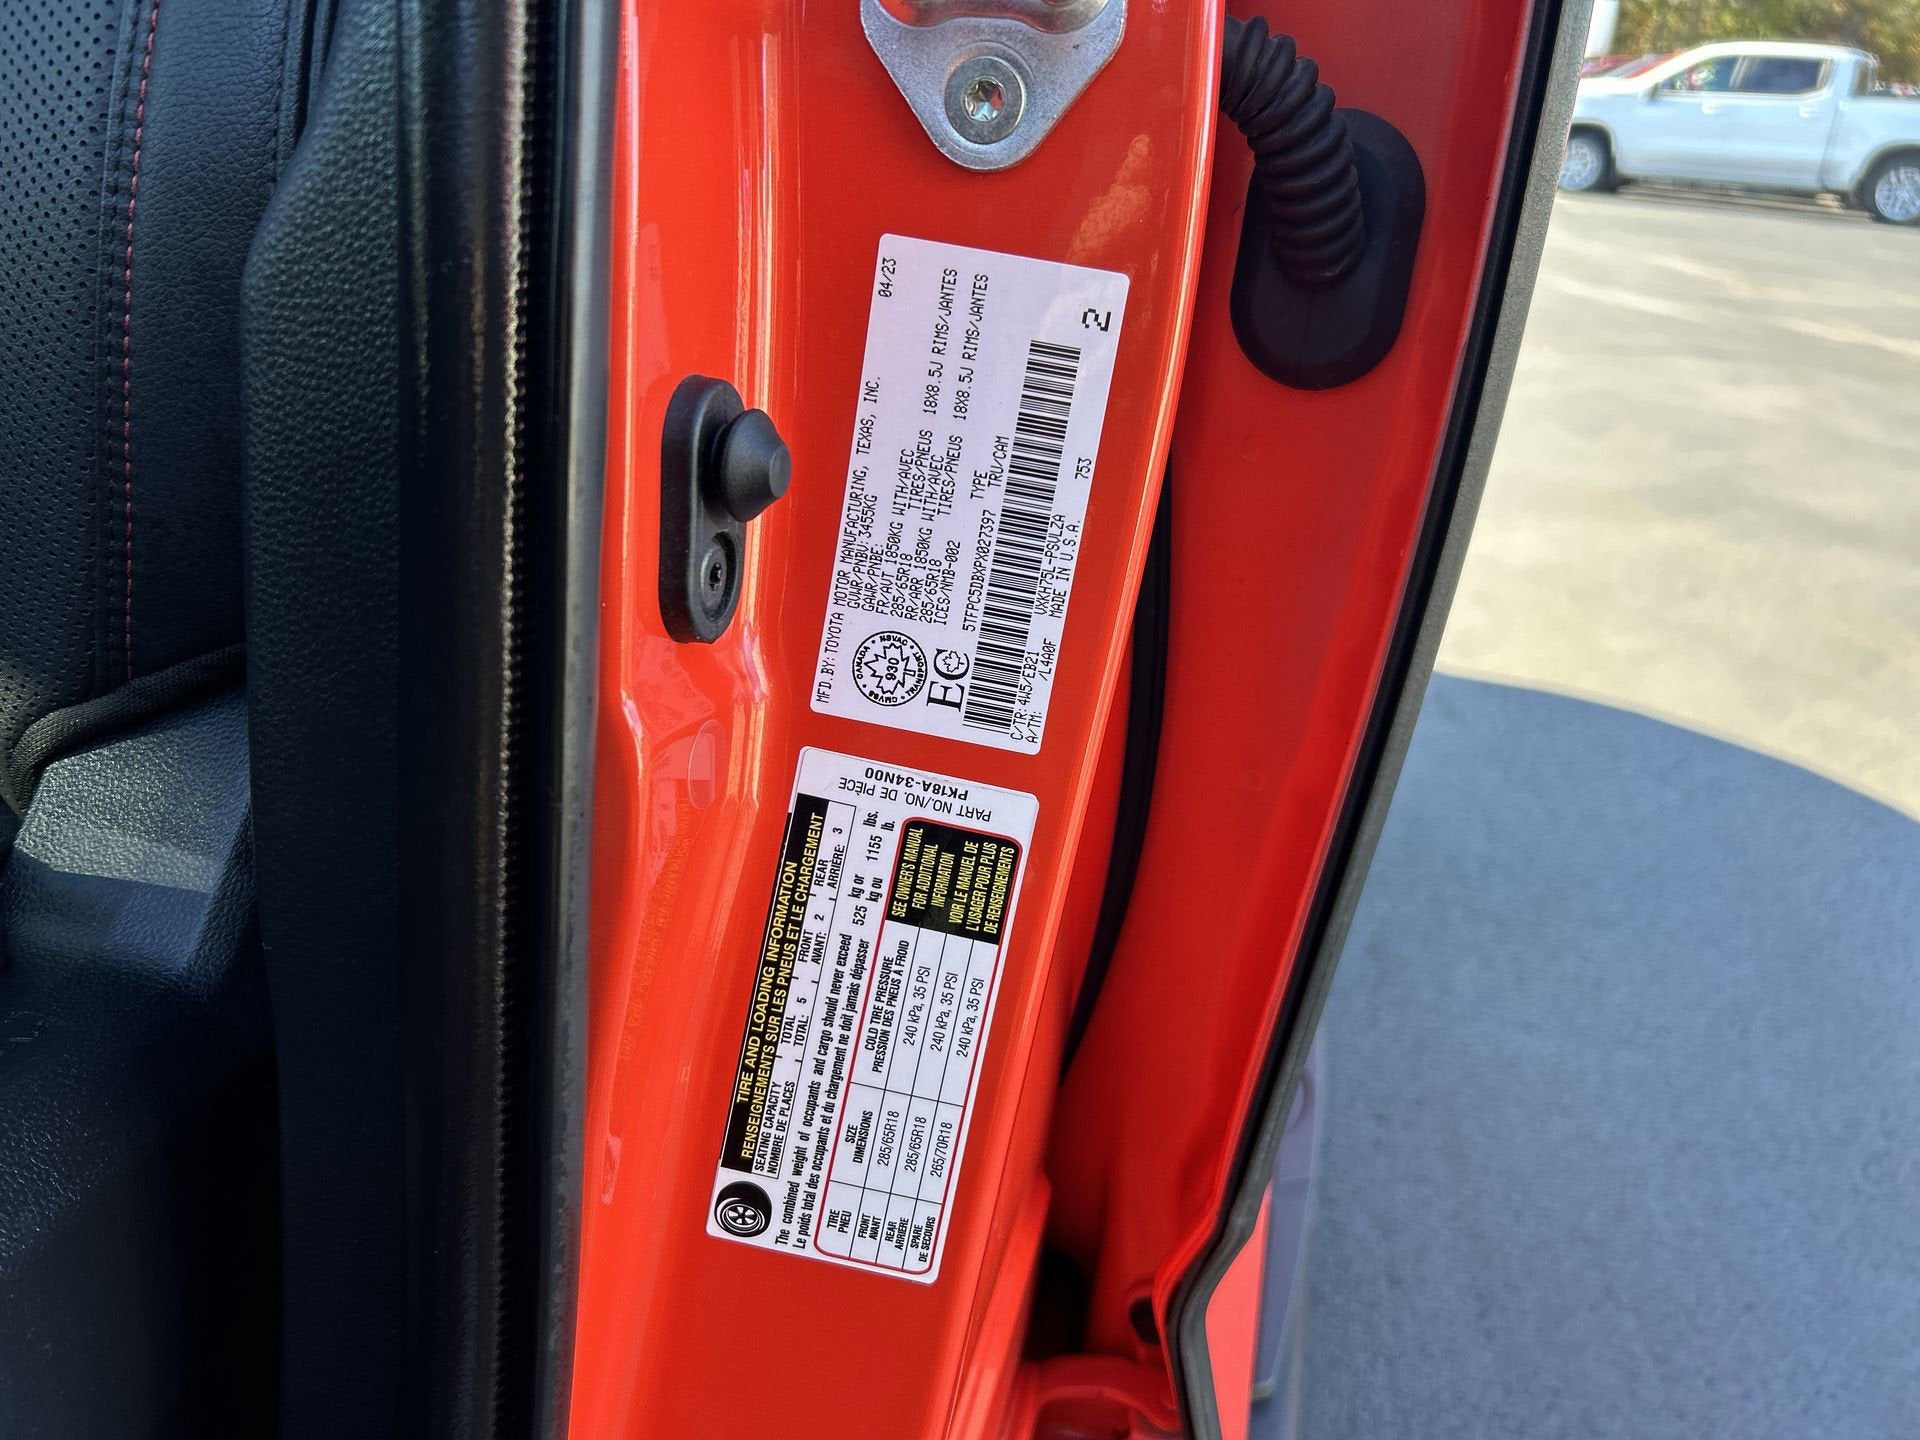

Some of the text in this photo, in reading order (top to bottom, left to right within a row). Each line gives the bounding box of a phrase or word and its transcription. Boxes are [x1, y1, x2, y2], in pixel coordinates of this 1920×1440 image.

[877, 256, 897, 298] 04/23
[1080, 306, 1111, 332] 2
[862, 374, 880, 403] INC.
[855, 412, 877, 456] TEXAS,
[889, 267, 959, 618] 285/65R18 TIRES/PNEUS 18X8.5J RIMS/JANTES
[918, 272, 989, 623] 285/65R18 TIRES/PNEUS 18X8.5J RIMS/JANTES
[969, 469, 988, 501] TYPE
[1074, 456, 1092, 481] 753
[839, 463, 869, 565] MANUFACTURING,
[875, 447, 915, 615] FR/AVT 1850KG WITH/AVEC
[961, 434, 1009, 632] 5TFPC5DBXPX027397 TRU/CAM
[904, 453, 944, 620] RR/ARR 1850KG WITH/AVEC
[861, 542, 884, 612] GAWR/PNBE:
[933, 538, 961, 625] ICES/NMB-002
[1033, 512, 1066, 616] VXKH75L-PSVLZA
[1048, 517, 1081, 618] MADE IN U.S.A.
[832, 568, 851, 607] MOTOR
[853, 644, 871, 680] CANADA
[884, 656, 899, 682] 930
[904, 650, 927, 698] TRANSPORT
[1023, 710, 1043, 744] A/TM:
[836, 775, 876, 798] PIÈCE
[863, 765, 969, 801] PK18A-34N00
[879, 785, 899, 801] DE
[831, 825, 843, 835] 3
[862, 808, 879, 827] lbs.
[879, 817, 895, 832] lb.
[955, 803, 992, 822] PART
[824, 842, 846, 889] ARRIÈRE:
[864, 833, 883, 863] 1155
[813, 857, 829, 887] REAR
[847, 873, 865, 899] kg or
[864, 876, 883, 903] kg ou
[890, 825, 924, 917] SEE OWNER'S MANUAL
[910, 841, 938, 910] FOR ADDITIONAL
[930, 850, 956, 908] INFORMATION
[947, 839, 979, 925] VOIR LE MANUEL DE
[964, 840, 998, 932] L'USAGER POUR PLUS
[982, 845, 1015, 934] DE RENSEIGNEMENTS
[813, 912, 825, 921] 2
[851, 903, 868, 926] 525
[797, 928, 814, 963] FRONT
[810, 930, 827, 965] AVANT:
[894, 939, 910, 967] FROID
[735, 859, 798, 1104] TIRE AND LOADING INFORMATION
[740, 811, 824, 1159] RENSEIGNEMENTS SUR LES PNEUS ET LE CHARGEMENT
[796, 995, 807, 1004] 5
[885, 976, 902, 1008] PNEUS
[863, 954, 895, 1051] COLD TIRE PRESSURE
[881, 1008, 895, 1028] DES
[901, 964, 931, 1046] 240 kPa, 35 PSI
[929, 971, 959, 1052] 240 kPa, 35 PSI
[955, 976, 985, 1058] 240 kPa, 35 PSI
[779, 1013, 796, 1045] TOTAL
[792, 1013, 810, 1048] TOTAL:
[871, 1027, 891, 1073] PRESSION
[774, 932, 852, 1246] The combined weight of occupants and cargo should never exceed
[791, 937, 872, 1249] Le poids total des occupants et du chargement ne doit jamais dépasser
[753, 1080, 783, 1172] SEATING CAPACITY
[766, 1079, 796, 1175] NOMBRE DE PLACES
[844, 1123, 858, 1144] SIZE
[852, 1109, 873, 1164] DIMENSIONS
[876, 1108, 900, 1167] 285/65R18
[903, 1114, 927, 1173] 285/65R18
[929, 1120, 953, 1178] 265/70R18
[826, 1207, 840, 1229] TIRE
[837, 1209, 852, 1234] PNEU
[857, 1212, 872, 1239] FRONT
[868, 1215, 882, 1240] AVANT
[884, 1220, 897, 1242] REAR
[909, 1223, 923, 1249] SPARE
[917, 1215, 936, 1263] DE SECOURS
